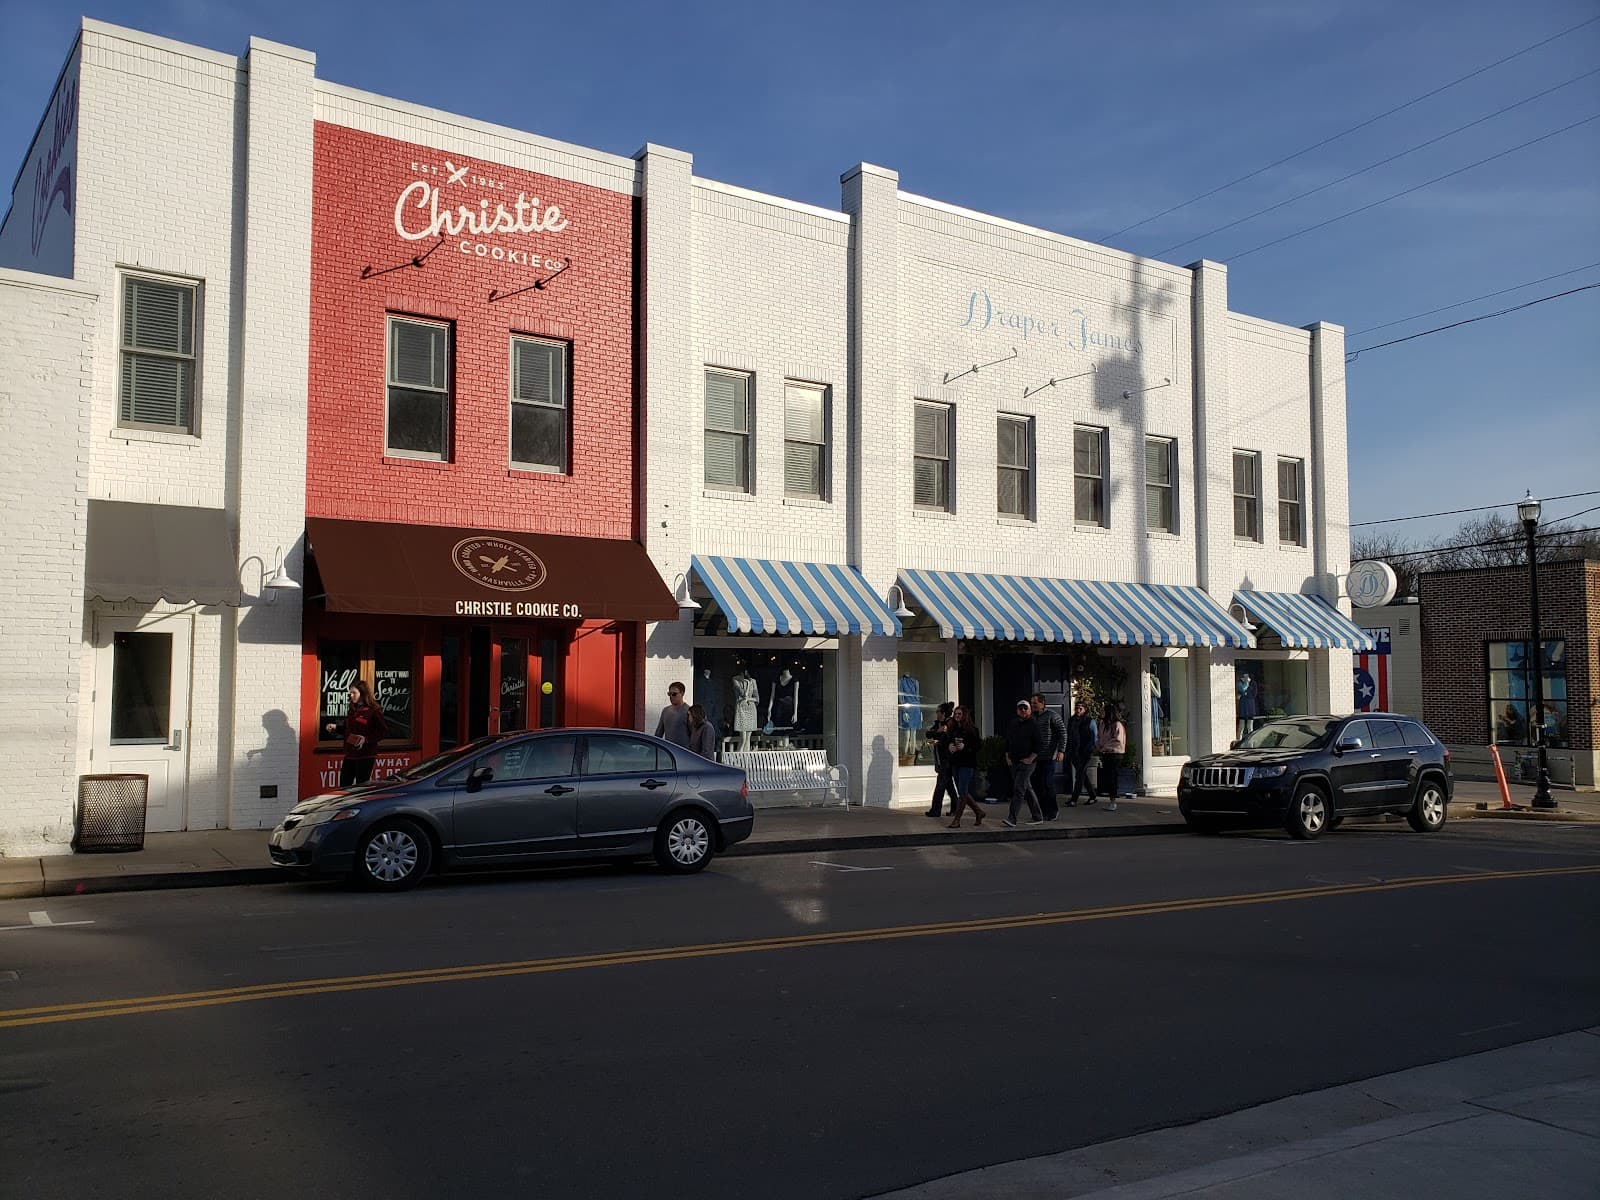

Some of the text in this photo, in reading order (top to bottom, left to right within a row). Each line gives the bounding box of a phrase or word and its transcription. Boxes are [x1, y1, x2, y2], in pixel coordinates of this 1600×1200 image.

[411, 162, 504, 190] EST. 1983
[394, 180, 569, 240] Christie
[459, 240, 542, 268] COOKIE
[960, 288, 1143, 353] Draper James
[486, 541, 512, 552] WHOLE
[455, 600, 582, 618] CHRISTIE COOKIE CO.
[375, 670, 385, 678] WE
[373, 680, 409, 700] Serve
[501, 679, 526, 695] Christie
[327, 692, 350, 704] COME
[327, 704, 338, 716] ON
[375, 758, 411, 767] WHAT
